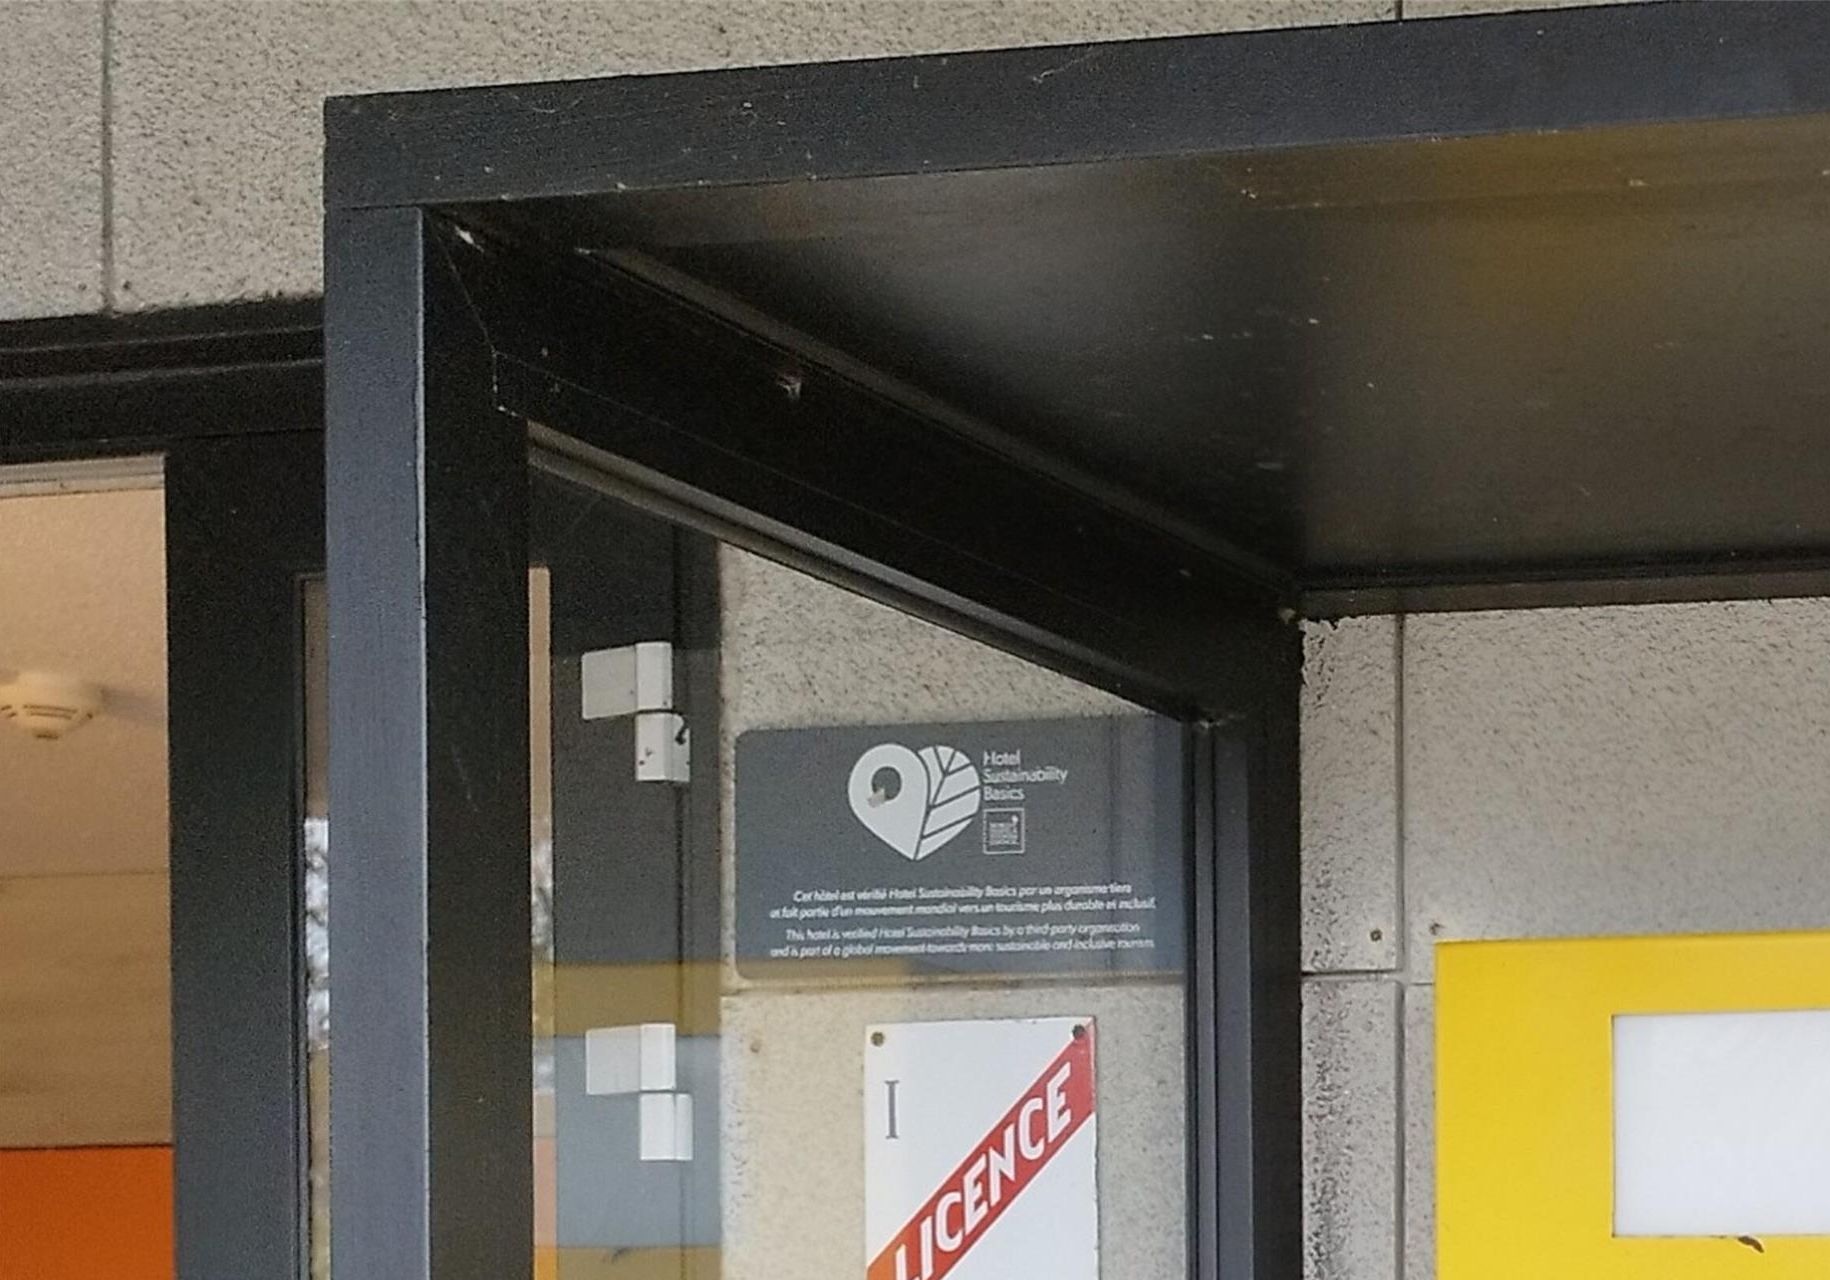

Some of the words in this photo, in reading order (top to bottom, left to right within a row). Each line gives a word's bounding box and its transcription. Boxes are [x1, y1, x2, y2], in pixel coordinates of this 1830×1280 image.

[983, 749, 1021, 766] Hotel
[983, 765, 1068, 784] Sustainability
[983, 785, 1025, 800] Basics
[888, 889, 916, 900] Hotel
[918, 886, 984, 899] Sustainability
[985, 885, 1016, 897] Basics
[1018, 887, 1037, 898] par
[1039, 886, 1052, 895] un
[800, 906, 829, 920] partie
[855, 905, 914, 916] mouvement
[915, 902, 957, 914] mondial
[1041, 900, 1062, 913] plus
[1064, 899, 1105, 910] durable
[786, 928, 805, 941] This
[806, 928, 831, 940] hotel
[879, 928, 905, 939] Hotel
[907, 925, 970, 939] Sustainability
[970, 925, 1001, 936] Basics
[1002, 925, 1014, 938] by
[1016, 926, 1024, 935] a
[770, 945, 789, 957] and
[800, 945, 820, 959] part
[822, 944, 832, 956] of
[833, 946, 841, 957] a
[841, 944, 874, 958] global
[874, 943, 926, 955] movement
[996, 940, 1051, 953] sustainable
[1052, 939, 1072, 951] and
[885, 1079, 900, 1140] I
